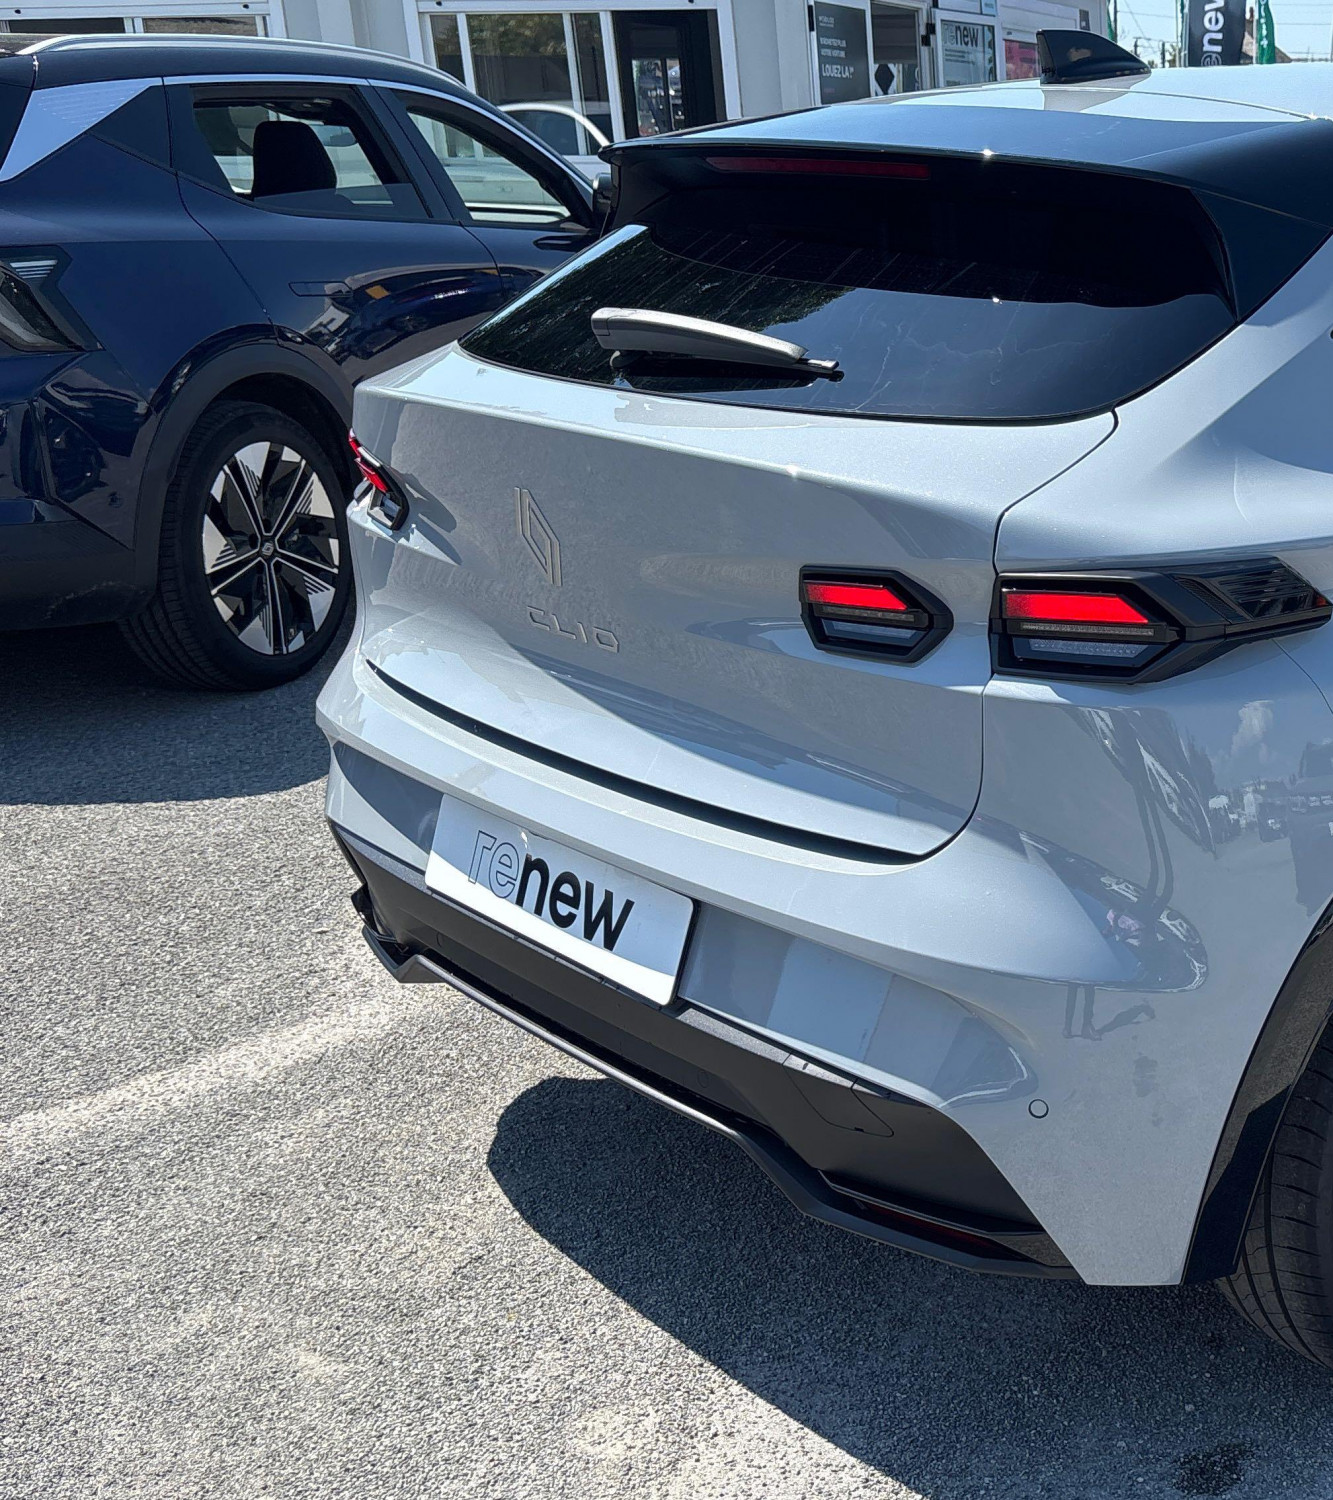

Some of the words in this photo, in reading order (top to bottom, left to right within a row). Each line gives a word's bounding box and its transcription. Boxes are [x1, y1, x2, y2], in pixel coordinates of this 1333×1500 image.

[943, 23, 979, 48] renew
[1200, 0, 1225, 66] ene
[527, 605, 620, 653] CLIO
[467, 829, 634, 952] renew
